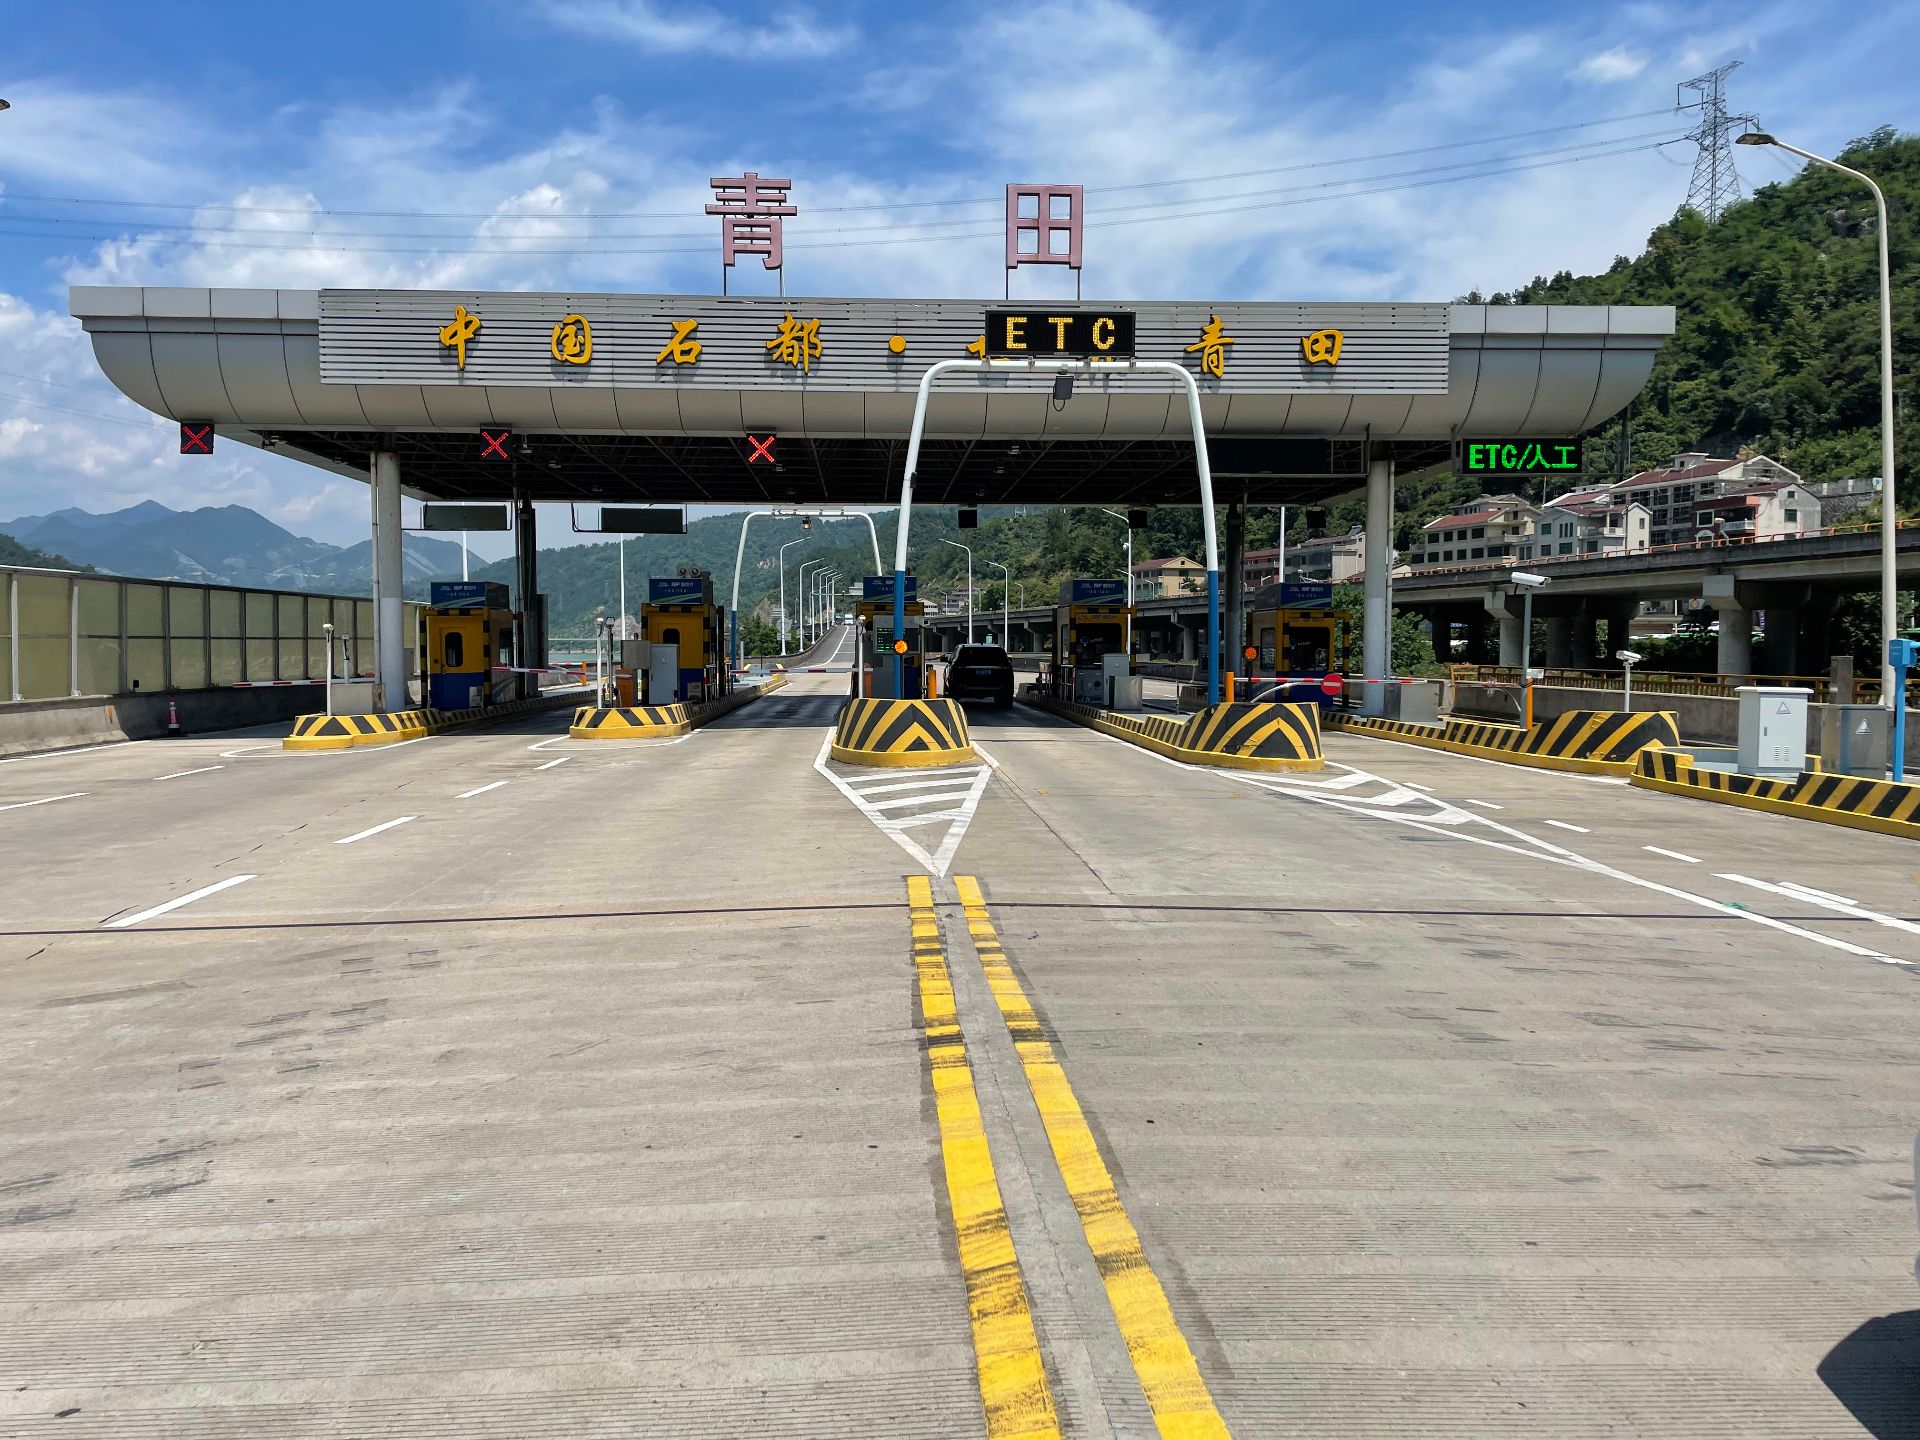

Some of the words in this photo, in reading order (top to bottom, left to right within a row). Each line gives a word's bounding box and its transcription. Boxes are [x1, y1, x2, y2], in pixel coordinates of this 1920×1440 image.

[705, 172, 1084, 270] 青田
[1006, 316, 1115, 350] ETC
[1469, 444, 1578, 470] ETC/人工
